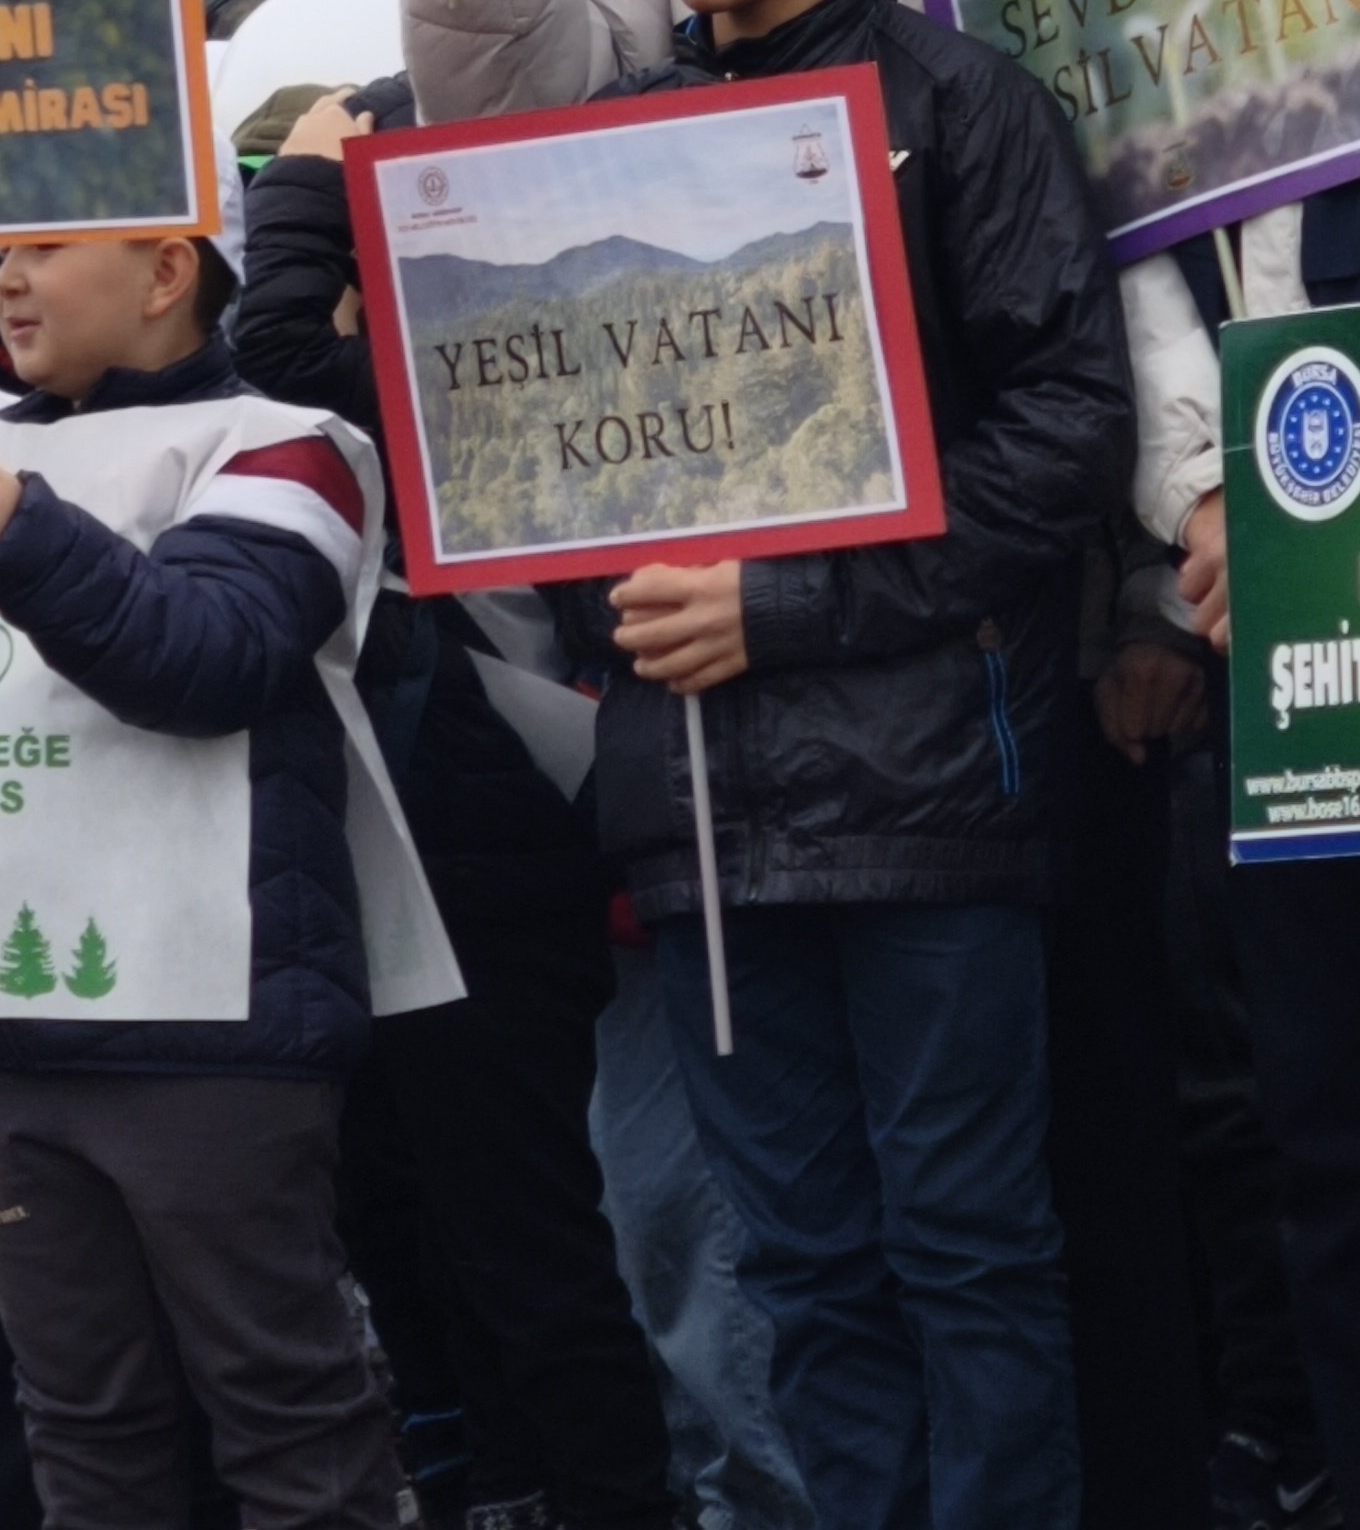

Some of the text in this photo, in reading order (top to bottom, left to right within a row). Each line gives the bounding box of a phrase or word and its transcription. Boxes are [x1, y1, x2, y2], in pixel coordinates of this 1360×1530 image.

[435, 292, 845, 391] YEŞİL VATANI
[554, 400, 736, 471] KORU!
